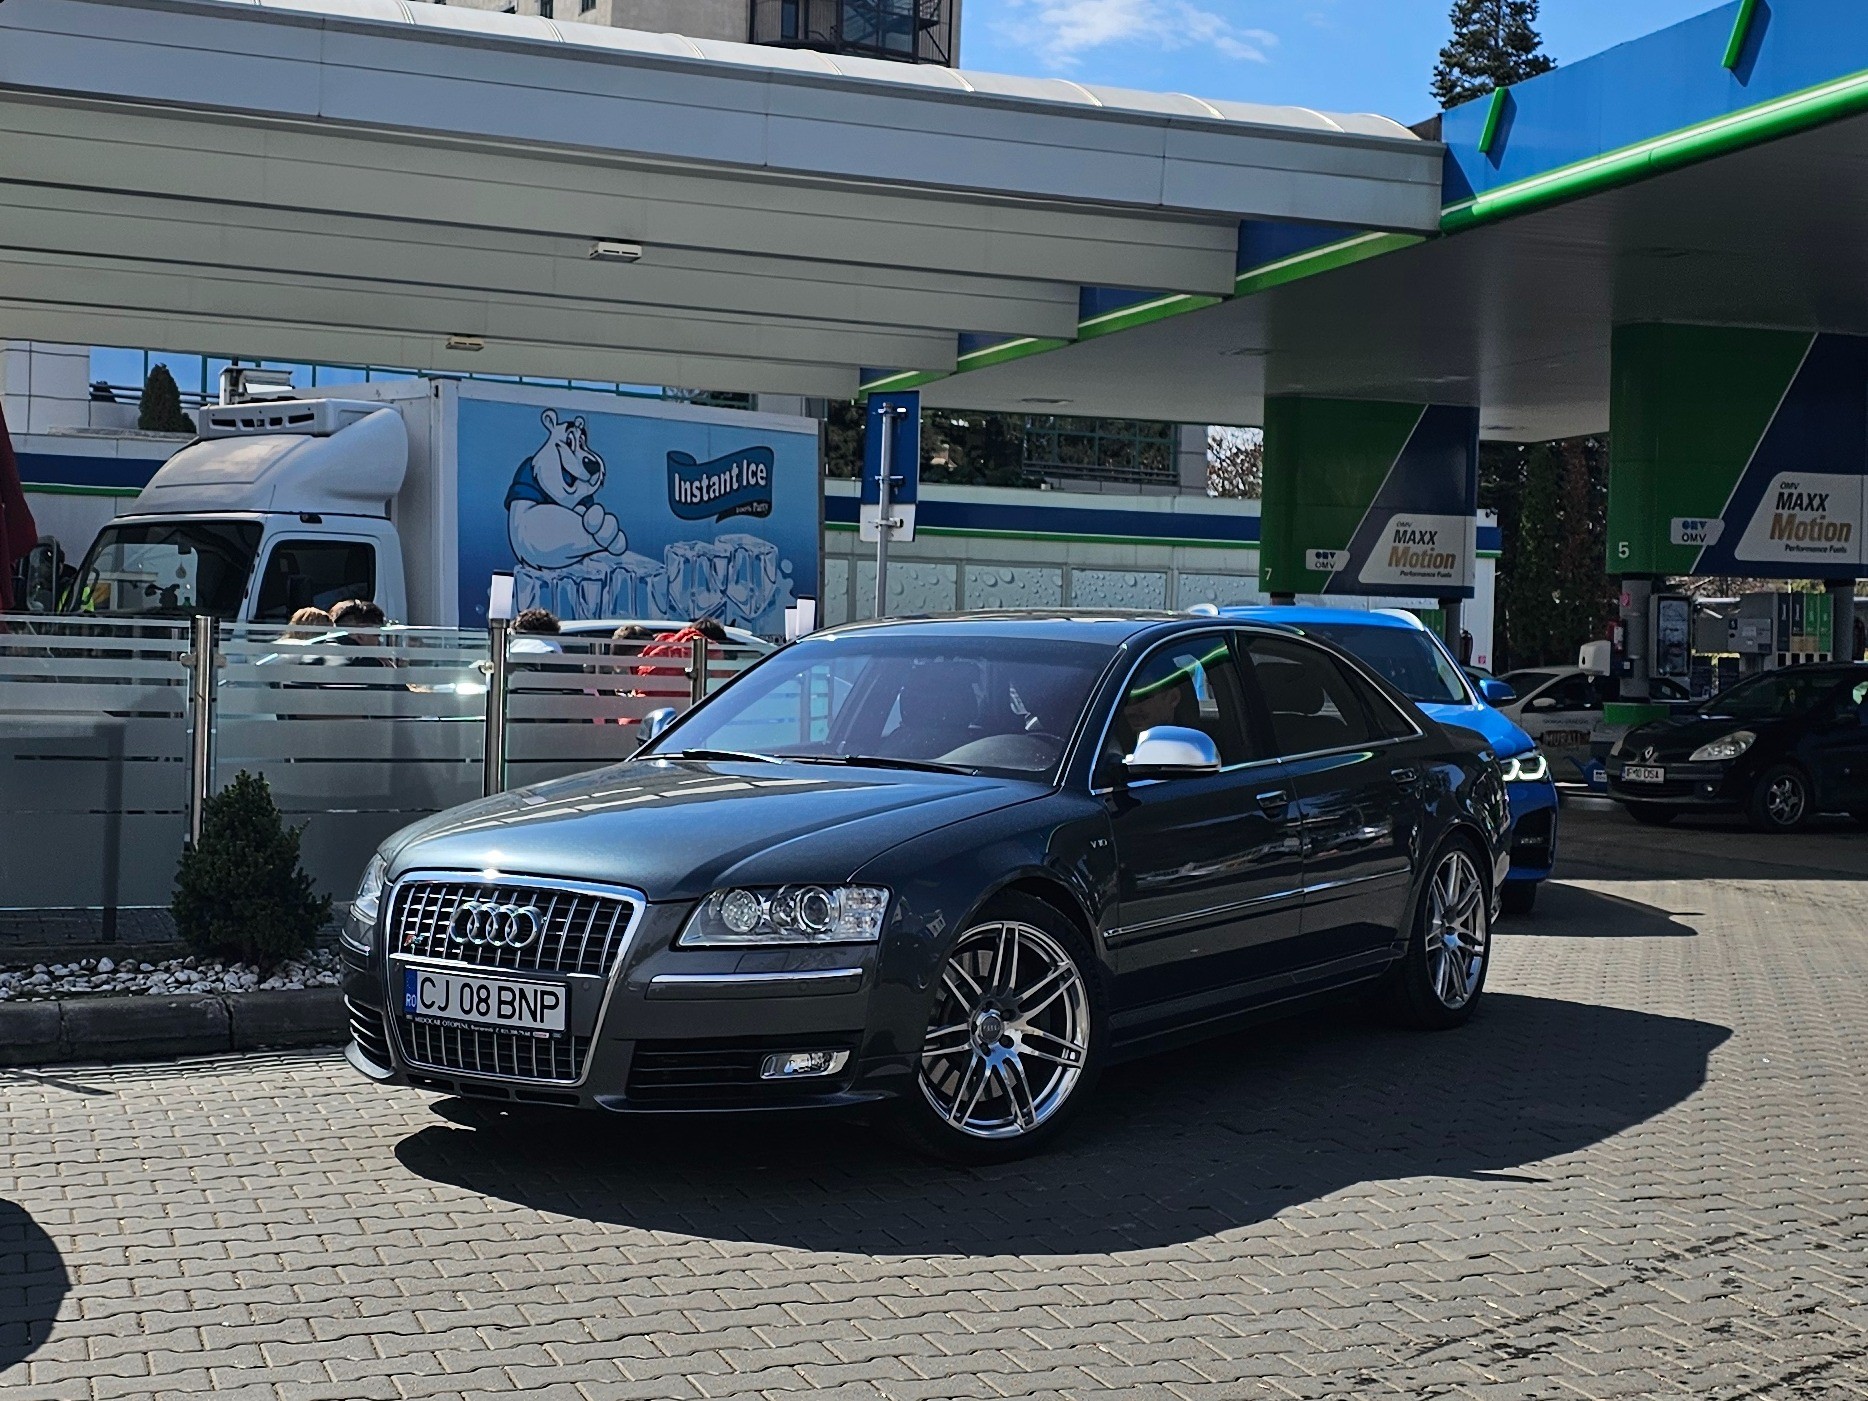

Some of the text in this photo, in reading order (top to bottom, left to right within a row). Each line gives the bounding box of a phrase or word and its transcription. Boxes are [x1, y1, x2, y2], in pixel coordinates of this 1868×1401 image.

[674, 459, 767, 504] Instant Ice
[1780, 481, 1800, 490] OMV
[1775, 491, 1830, 512] MAXX
[1769, 512, 1853, 543] Motion
[1393, 529, 1439, 546] MAXX
[1681, 532, 1707, 543] OMV
[1618, 541, 1630, 559] 5
[1784, 543, 1848, 554] Performance Fuels
[1314, 561, 1336, 570] OMV
[1387, 545, 1457, 570] Motion
[1264, 567, 1273, 581] 7
[1399, 570, 1453, 579] Performance Fuels
[405, 976, 560, 1024] RO CJ 08 BNP
